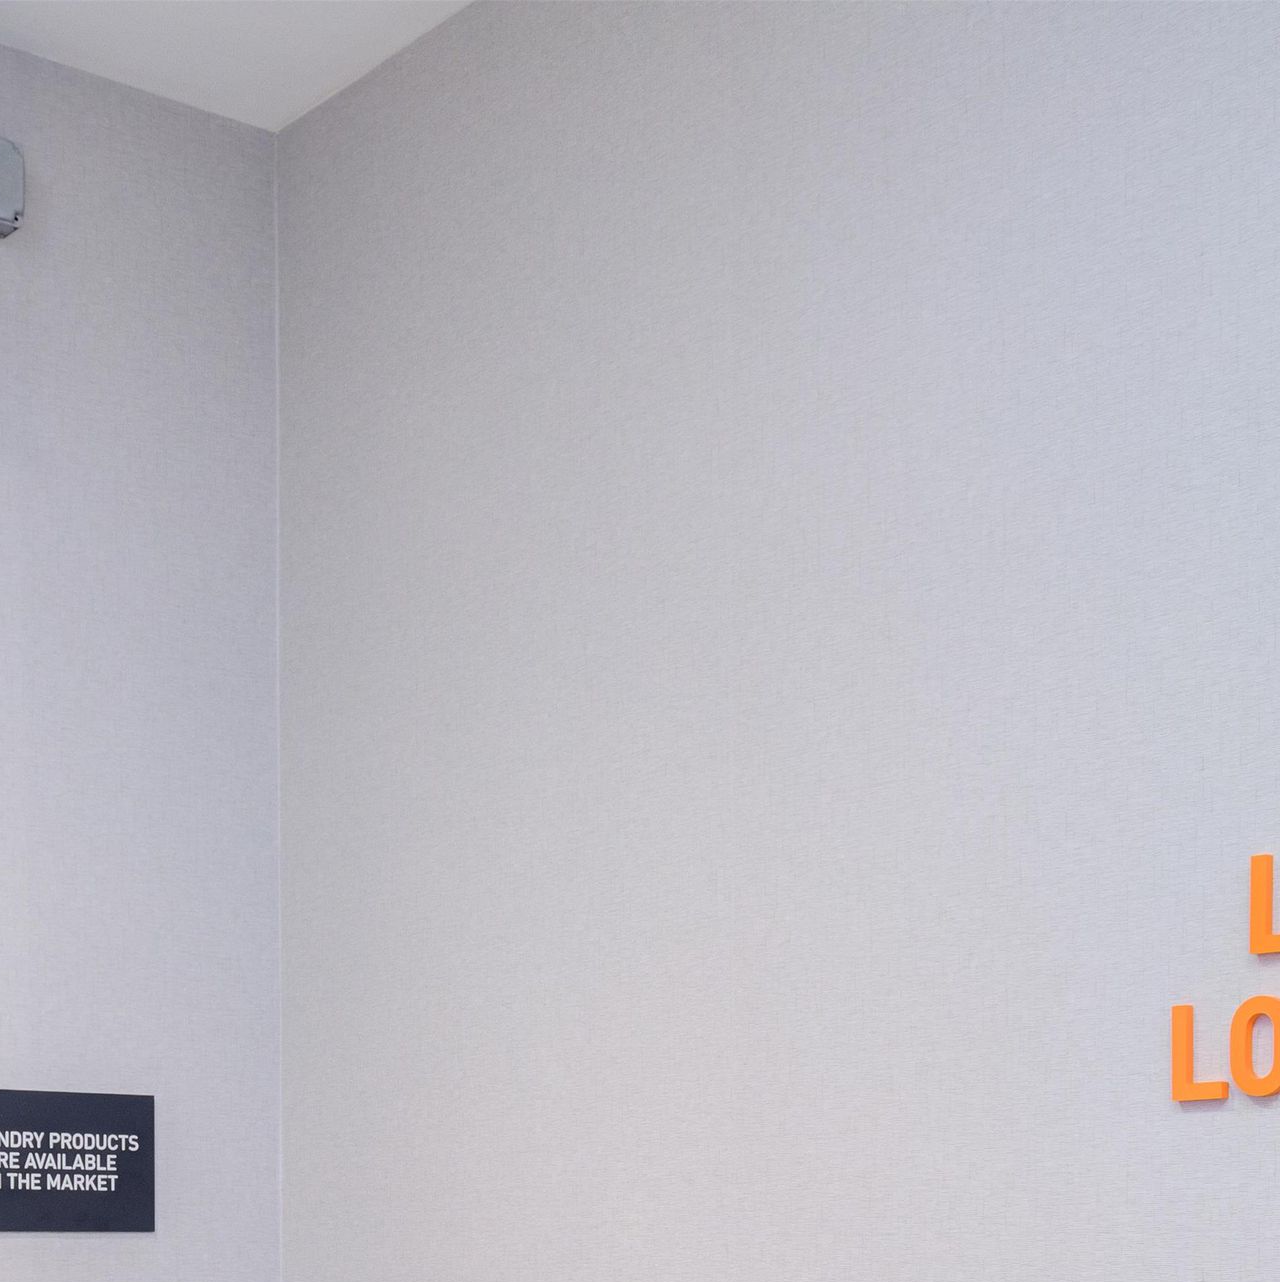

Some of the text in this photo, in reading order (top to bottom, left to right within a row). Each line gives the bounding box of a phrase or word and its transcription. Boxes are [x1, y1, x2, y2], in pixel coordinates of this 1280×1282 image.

[49, 1132, 139, 1151] PRODUCTS
[24, 1153, 117, 1171] AVAILABLE
[7, 1172, 41, 1190] THE
[46, 1174, 118, 1191] MARKET
